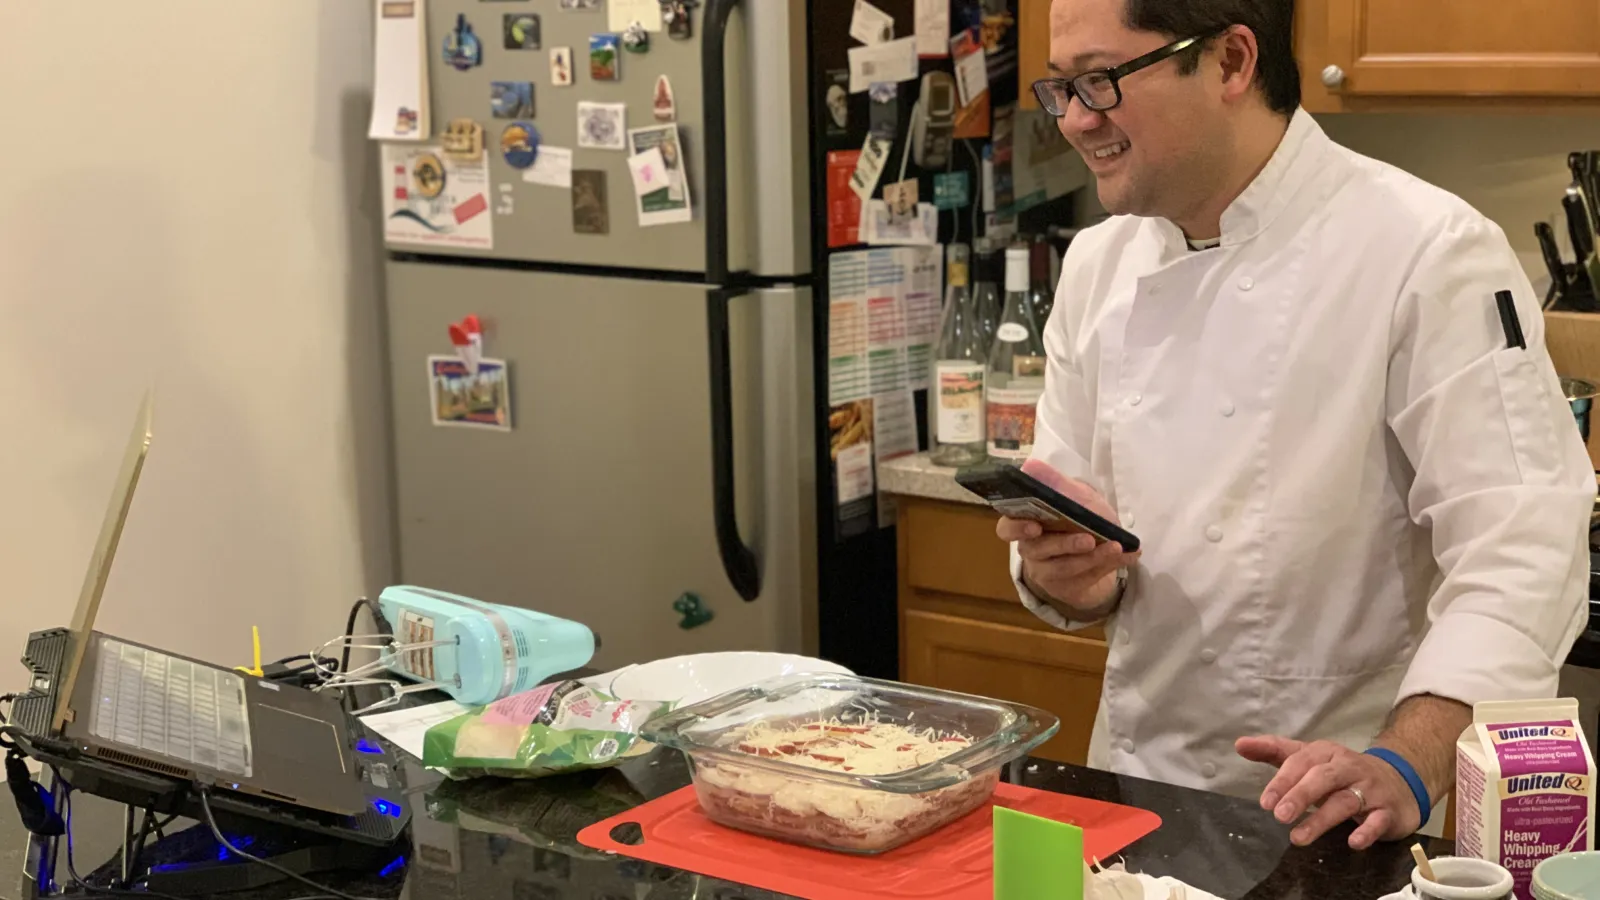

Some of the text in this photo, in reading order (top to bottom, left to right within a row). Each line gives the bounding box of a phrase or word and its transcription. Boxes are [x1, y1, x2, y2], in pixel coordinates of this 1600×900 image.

[1498, 726, 1549, 740] United
[1504, 750, 1577, 761] Heavy Whipping Cream
[1507, 774, 1565, 793] United
[1518, 796, 1572, 806] Old Fashioned
[1514, 816, 1574, 826] ultra-pasteurized
[1504, 829, 1540, 843] Heavy
[1503, 842, 1561, 857] Whipping
